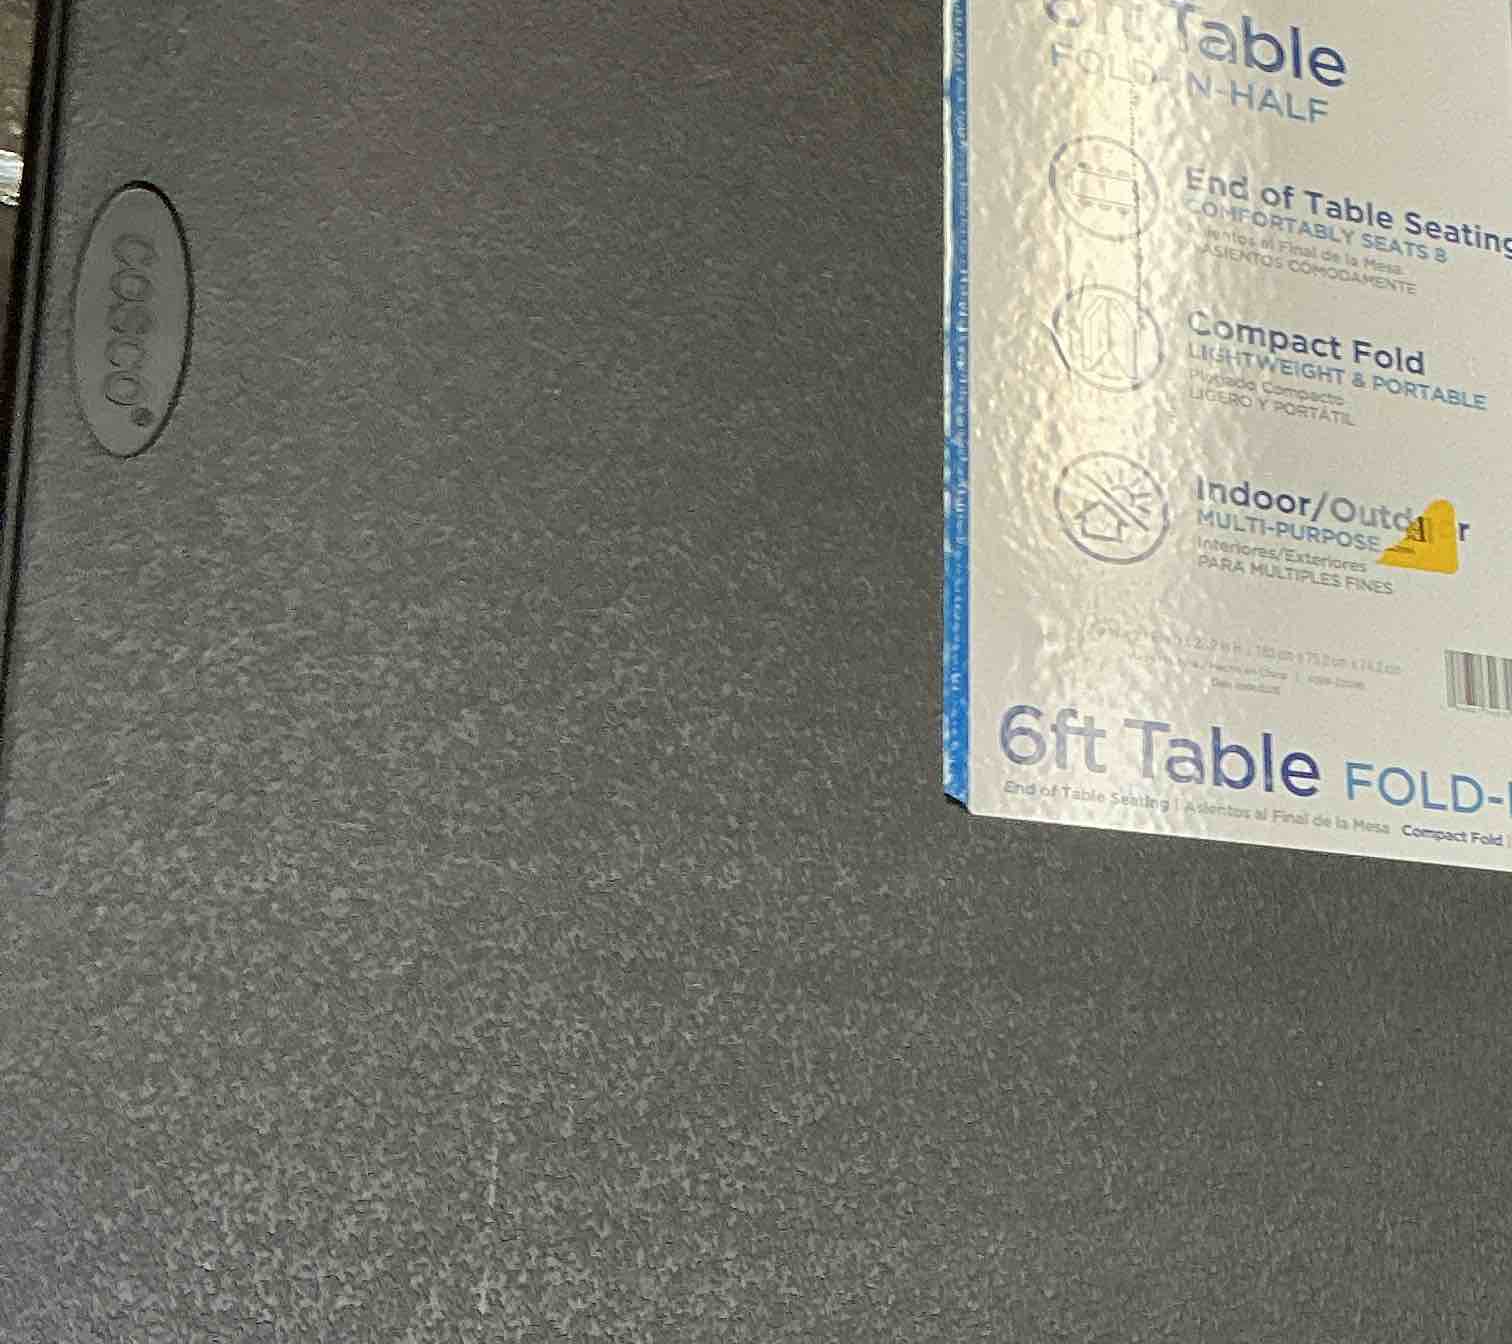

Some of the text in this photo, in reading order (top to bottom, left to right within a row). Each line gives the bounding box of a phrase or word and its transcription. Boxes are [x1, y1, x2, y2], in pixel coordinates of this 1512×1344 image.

[1166, 0, 1348, 88] Table
[1049, 41, 1329, 124] FOLD-N-HALF
[1185, 198, 1355, 246] COMFORTABLY
[1360, 231, 1429, 260] SEATS
[1186, 166, 1248, 201] End
[1261, 185, 1296, 209] of
[1304, 189, 1394, 231] Table
[1186, 309, 1426, 376] Compact Fold
[1187, 341, 1489, 411] LIGHTWEIGHT & PORTABLE
[1197, 474, 1471, 544] Indoor/Outdr
[1197, 508, 1383, 553] MULTI-PURPOSE
[1198, 554, 1246, 575] PARA
[1345, 575, 1394, 595] FINES
[1000, 702, 1108, 775] 6ft
[1123, 716, 1322, 798] Table
[1003, 780, 1037, 796] End
[1040, 783, 1058, 796] of
[1062, 786, 1106, 804] Table
[1111, 793, 1170, 813] Seating
[1272, 809, 1310, 826] Final
[1312, 814, 1331, 829] de
[1336, 816, 1350, 830] la
[1353, 820, 1391, 836] Mesa
[1400, 823, 1469, 844] Compact
[1471, 831, 1504, 847] Fold
